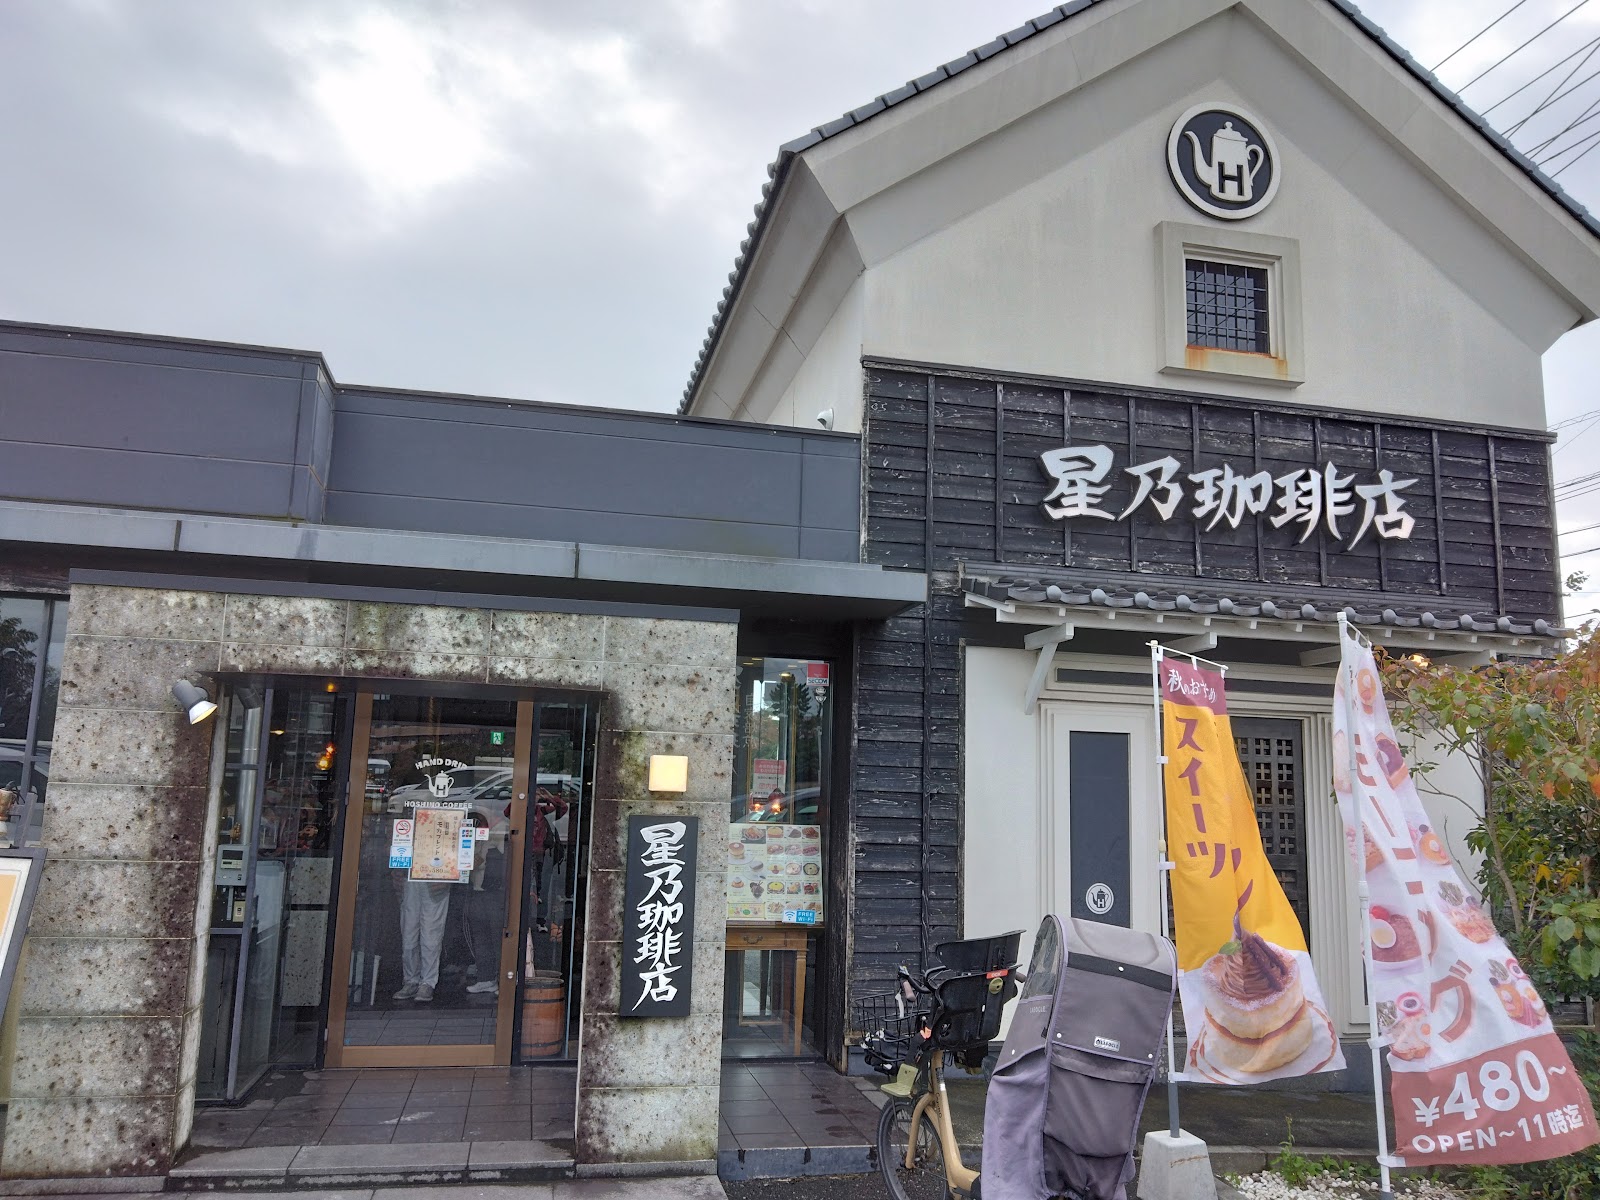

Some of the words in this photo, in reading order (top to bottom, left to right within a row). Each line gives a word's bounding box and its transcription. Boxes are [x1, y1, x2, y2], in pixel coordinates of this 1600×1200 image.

[1038, 443, 1420, 552] 星乃珈琲店
[404, 800, 440, 808] HOSHINO
[442, 801, 473, 809] COFFEE
[415, 758, 444, 770] HAND
[445, 758, 468, 770] DRIP
[1176, 716, 1241, 880] スイーツ
[631, 820, 687, 1012] 星乃珈琲店
